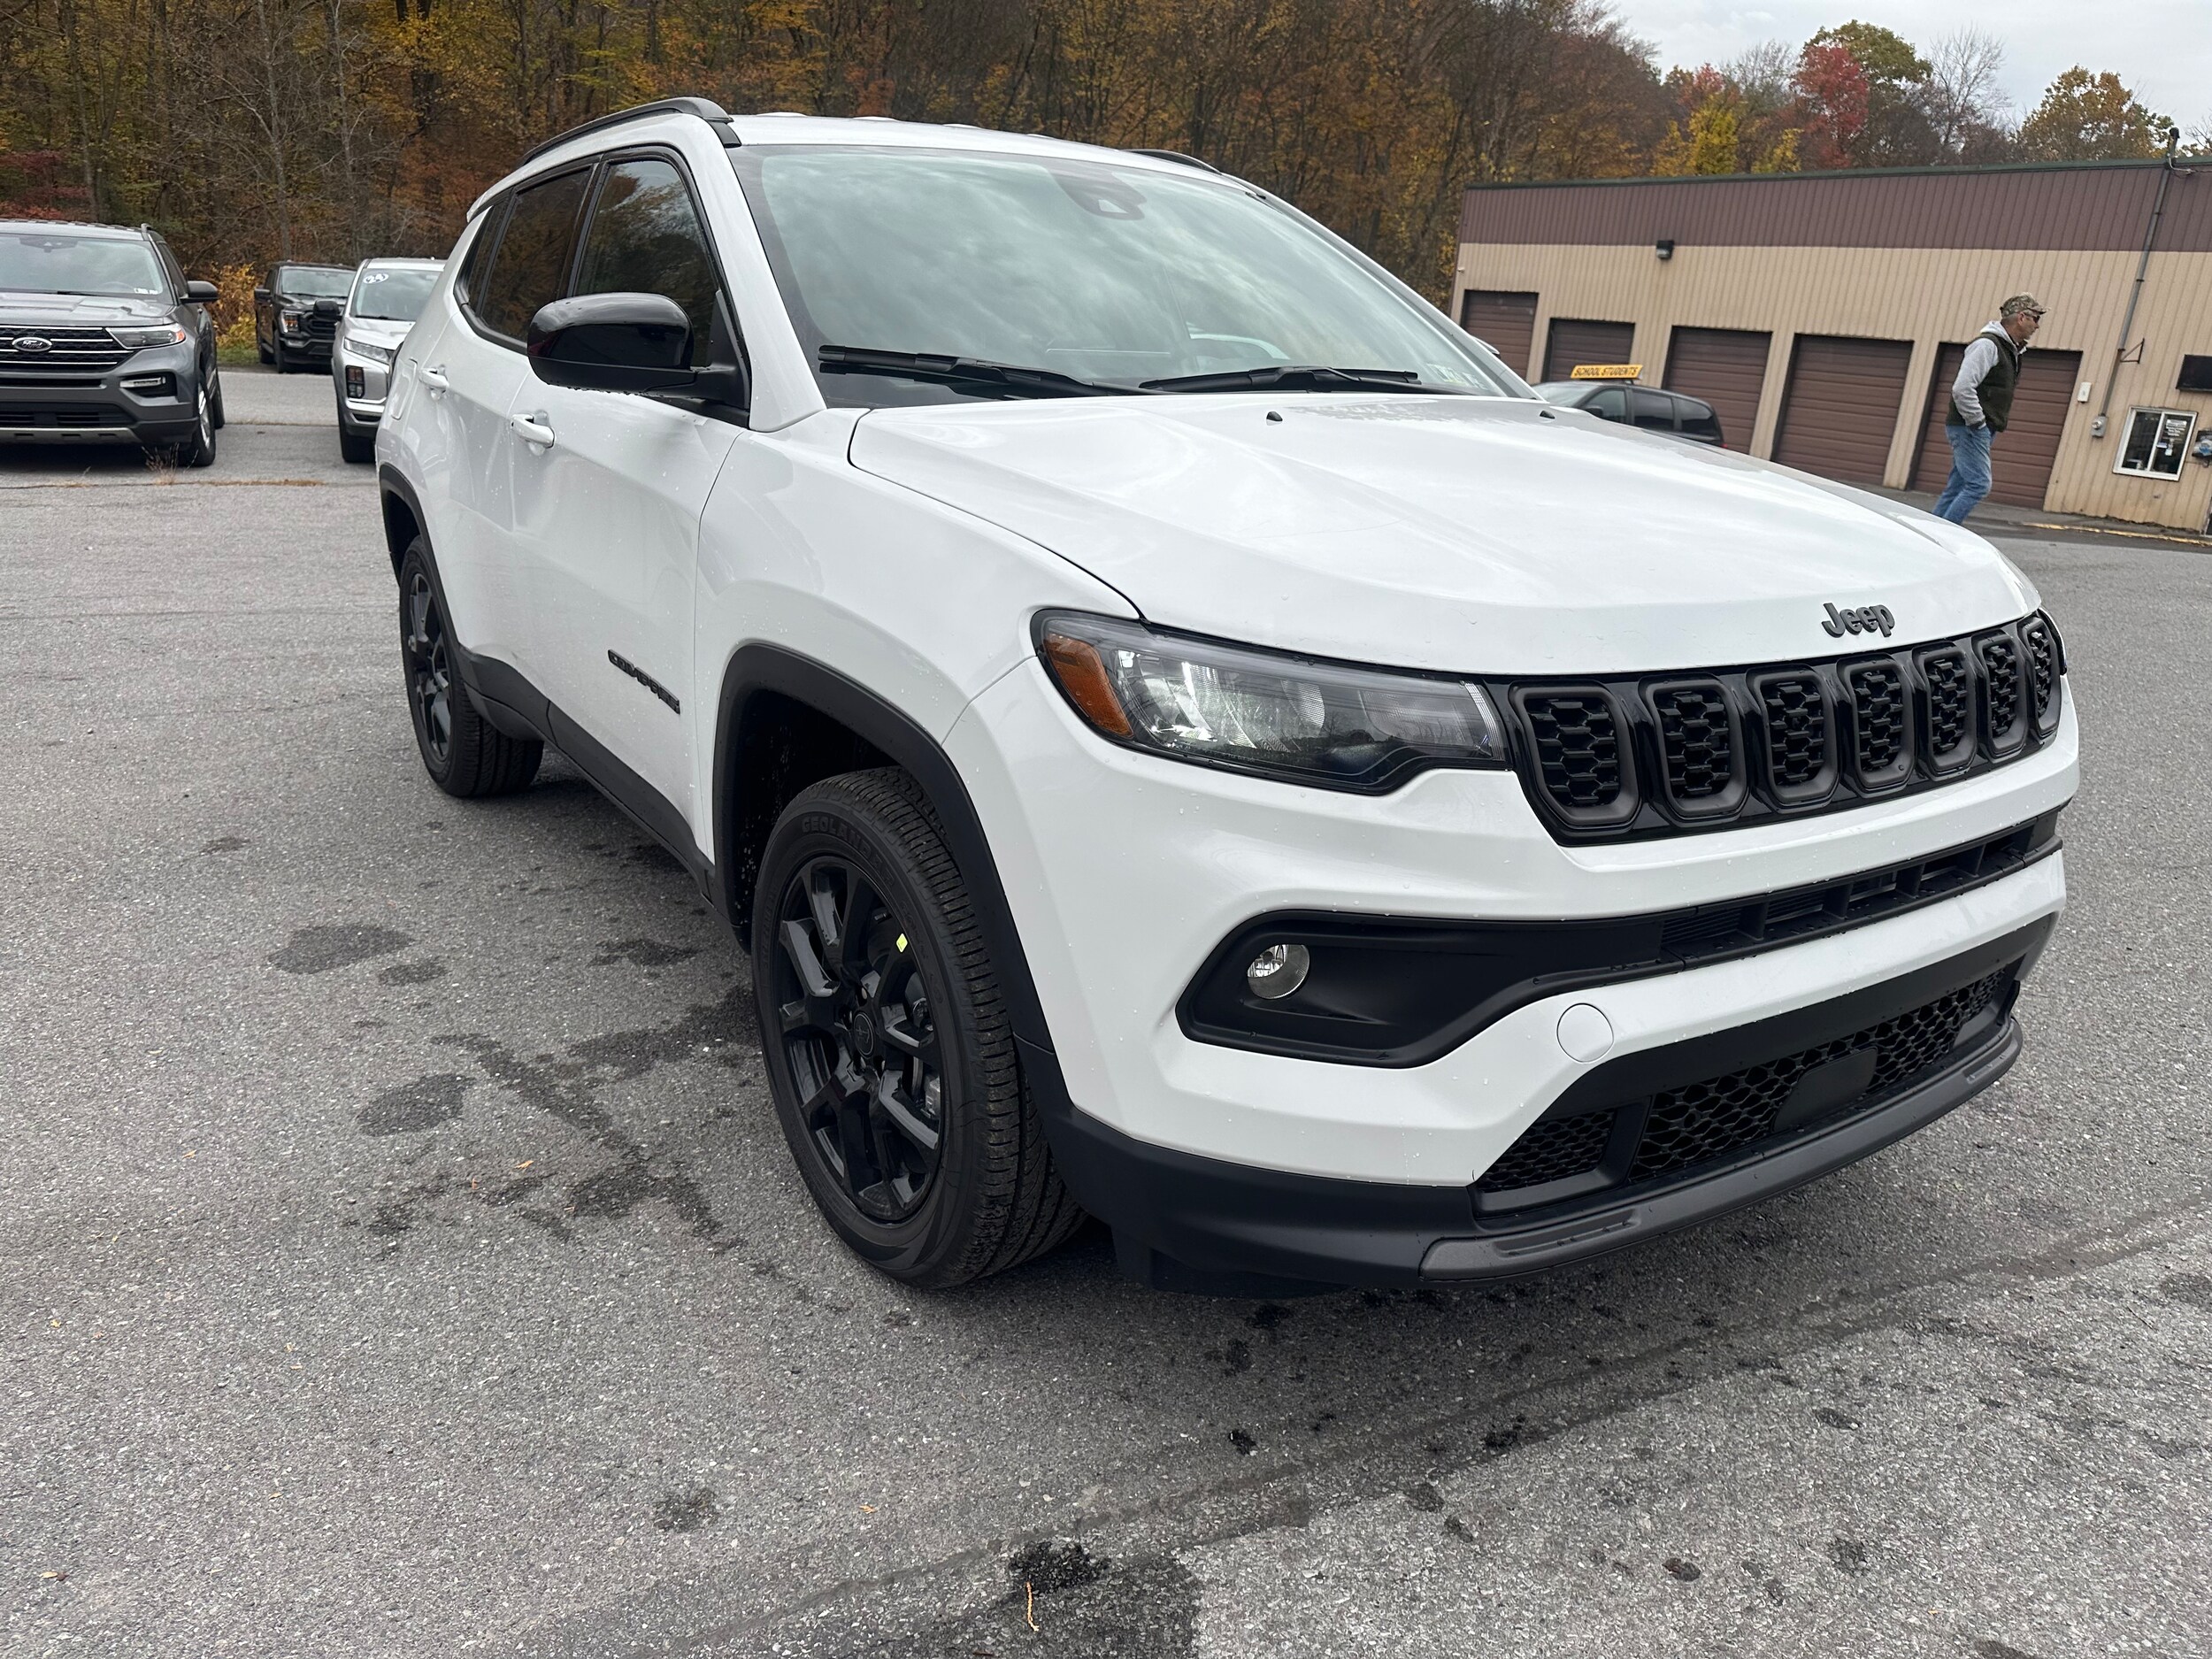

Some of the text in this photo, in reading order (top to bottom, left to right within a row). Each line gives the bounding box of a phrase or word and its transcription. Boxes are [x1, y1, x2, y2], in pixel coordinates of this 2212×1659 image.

[1574, 366, 1639, 376] SCHOOL STUDENTS
[1821, 603, 1895, 638] Jeep
